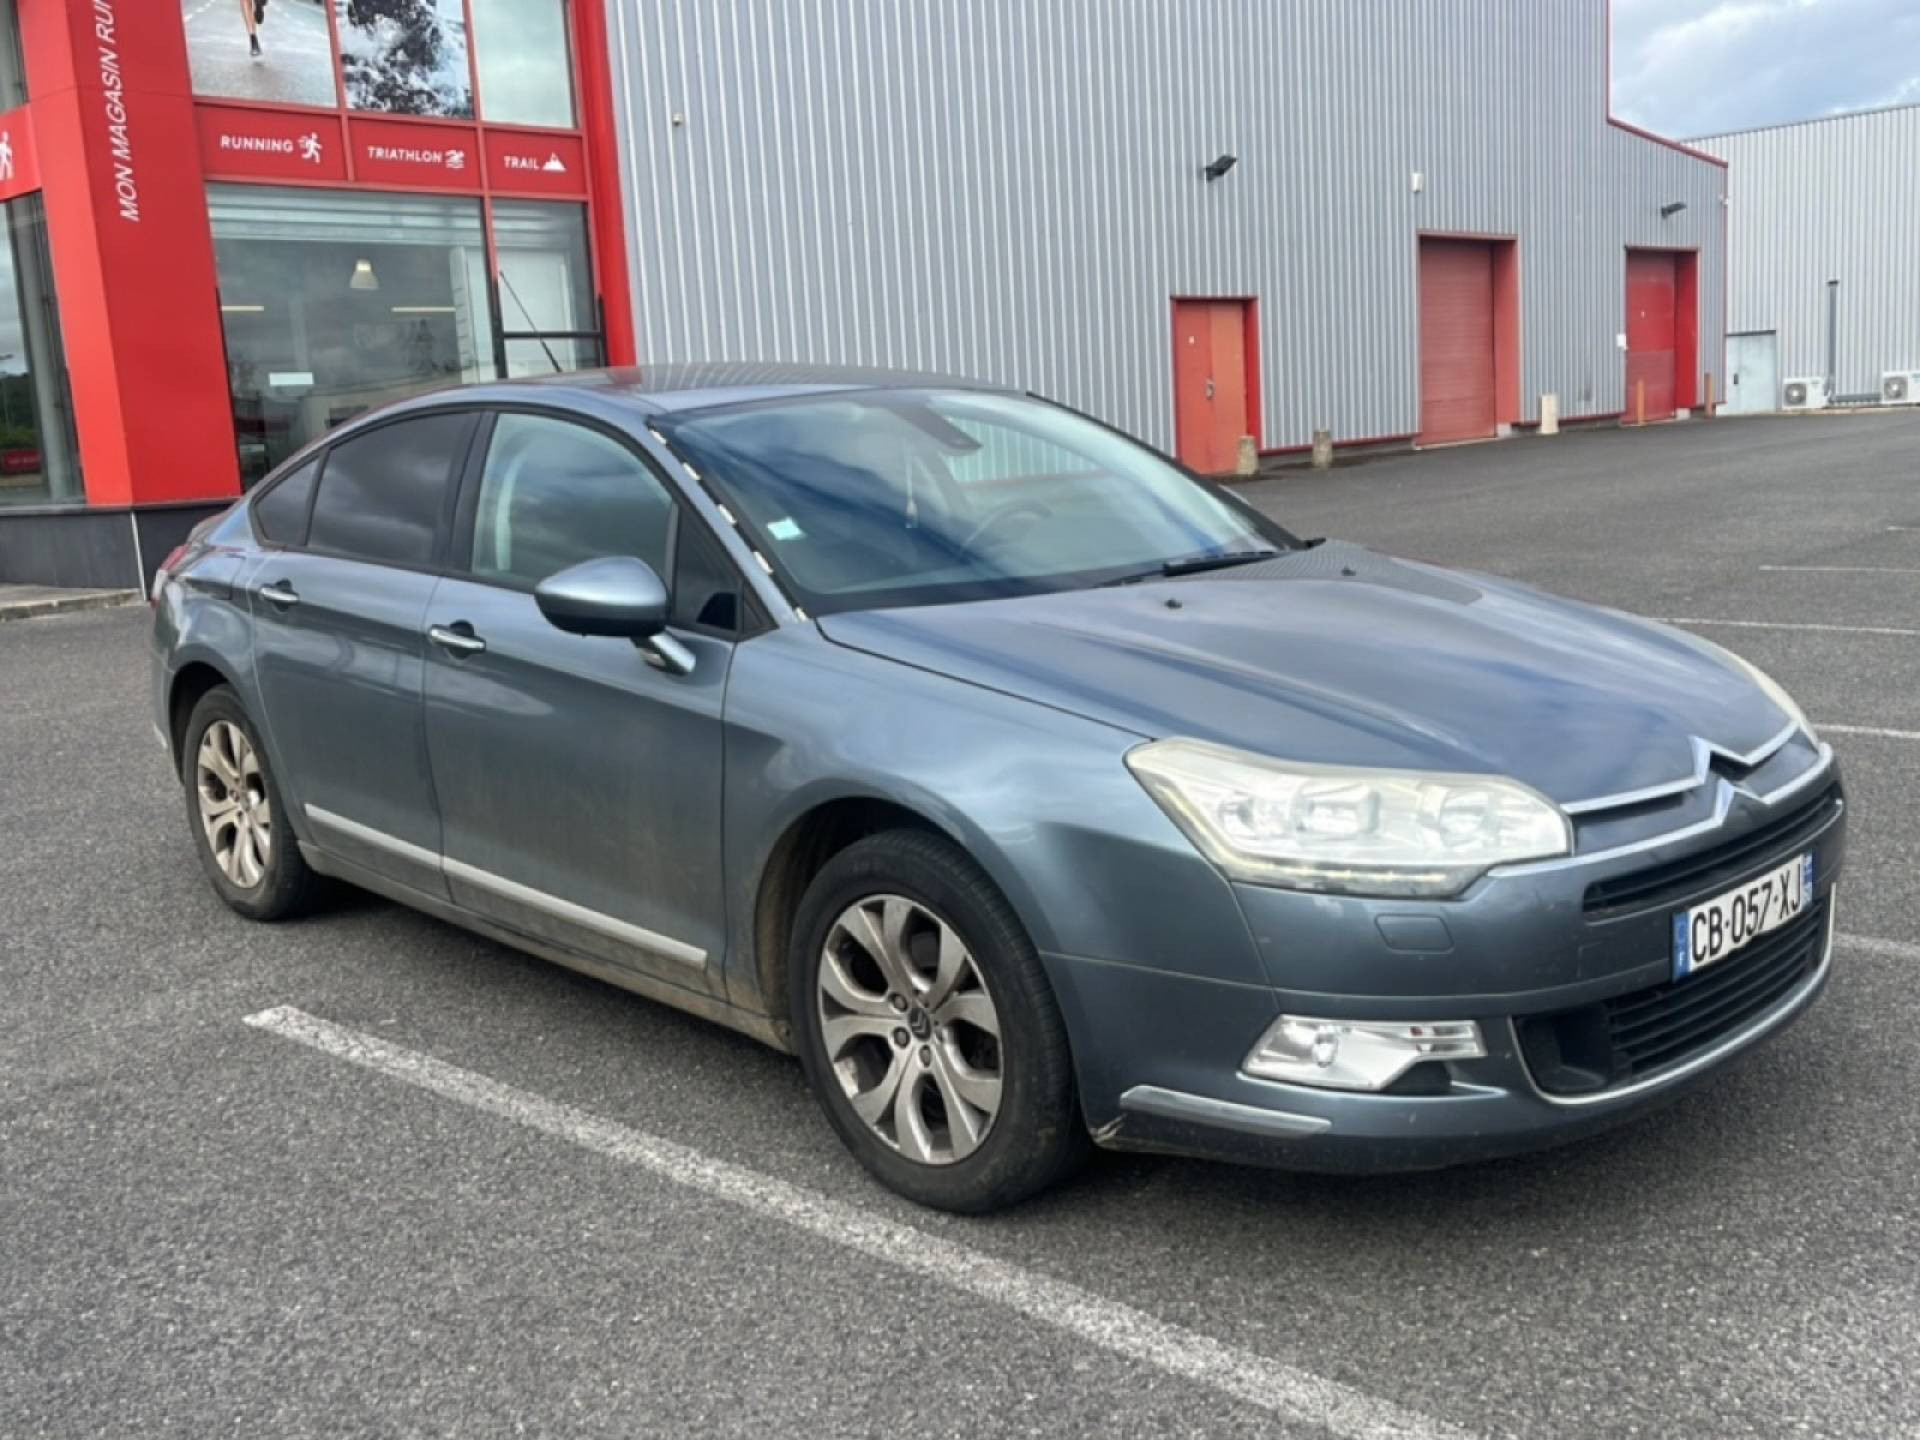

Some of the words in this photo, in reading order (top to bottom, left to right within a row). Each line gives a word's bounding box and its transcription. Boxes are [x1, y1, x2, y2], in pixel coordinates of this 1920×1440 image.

[98, 47, 132, 161] MAGASIN
[220, 135, 294, 153] RUNNING
[367, 146, 443, 164] TRIATHLON
[503, 155, 540, 170] TRAIL
[114, 163, 140, 222] MON
[1691, 863, 1801, 963] CB-057-XJ
